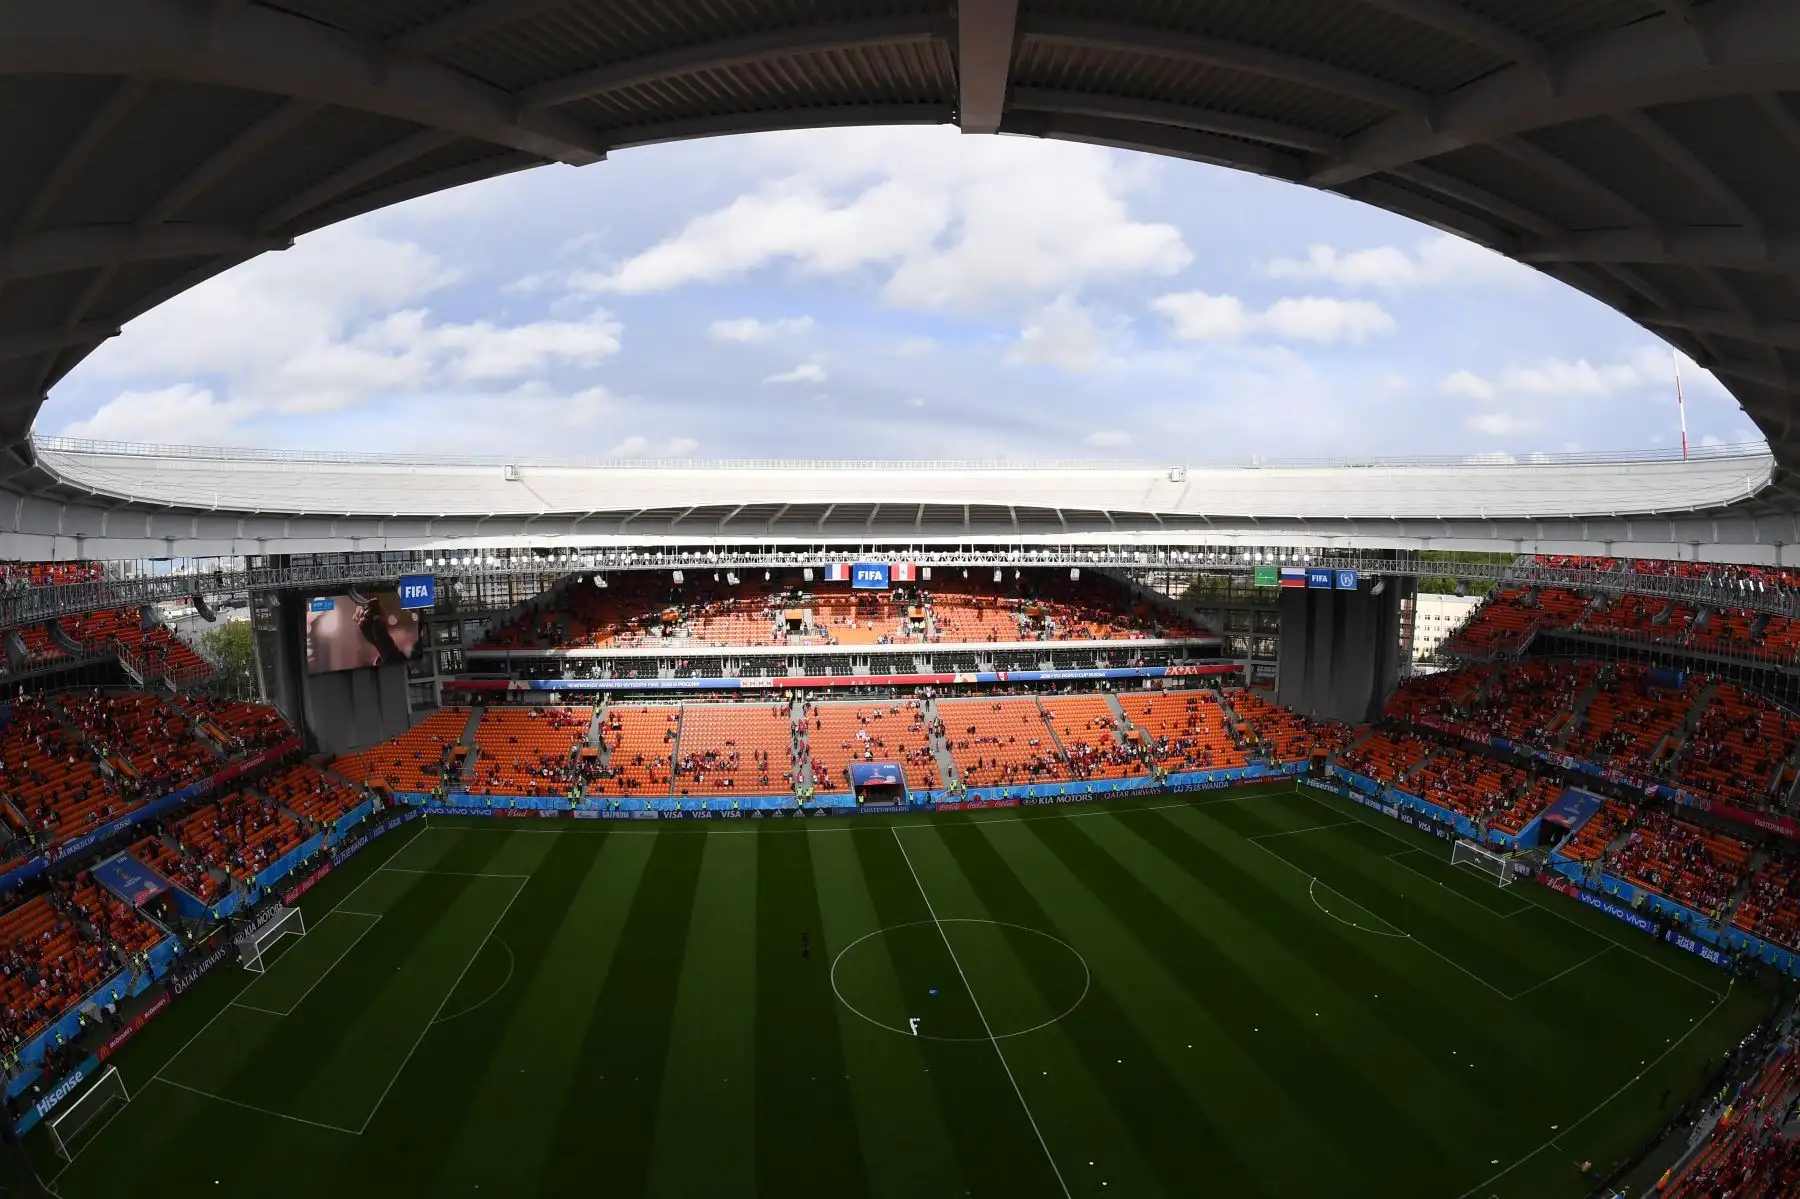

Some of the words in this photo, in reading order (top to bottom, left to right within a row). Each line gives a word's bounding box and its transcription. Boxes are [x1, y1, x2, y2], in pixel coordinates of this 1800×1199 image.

[857, 570, 883, 580] FIFA
[1311, 574, 1328, 582] FIFA
[405, 585, 428, 598] FIFA
[1306, 779, 1339, 793] Hisense
[1038, 796, 1054, 805] KIA
[1056, 793, 1093, 803] MOTORS
[1104, 788, 1129, 799] QATAR
[663, 811, 683, 819] VISA
[692, 810, 712, 819] VISA
[721, 810, 741, 818] VISA
[1401, 814, 1413, 825] VISA
[1418, 821, 1431, 833] VISA
[244, 925, 257, 938] KIA
[174, 970, 199, 994] QATAR
[199, 946, 226, 975] AIRWAYS
[36, 1070, 84, 1118] Hisense
